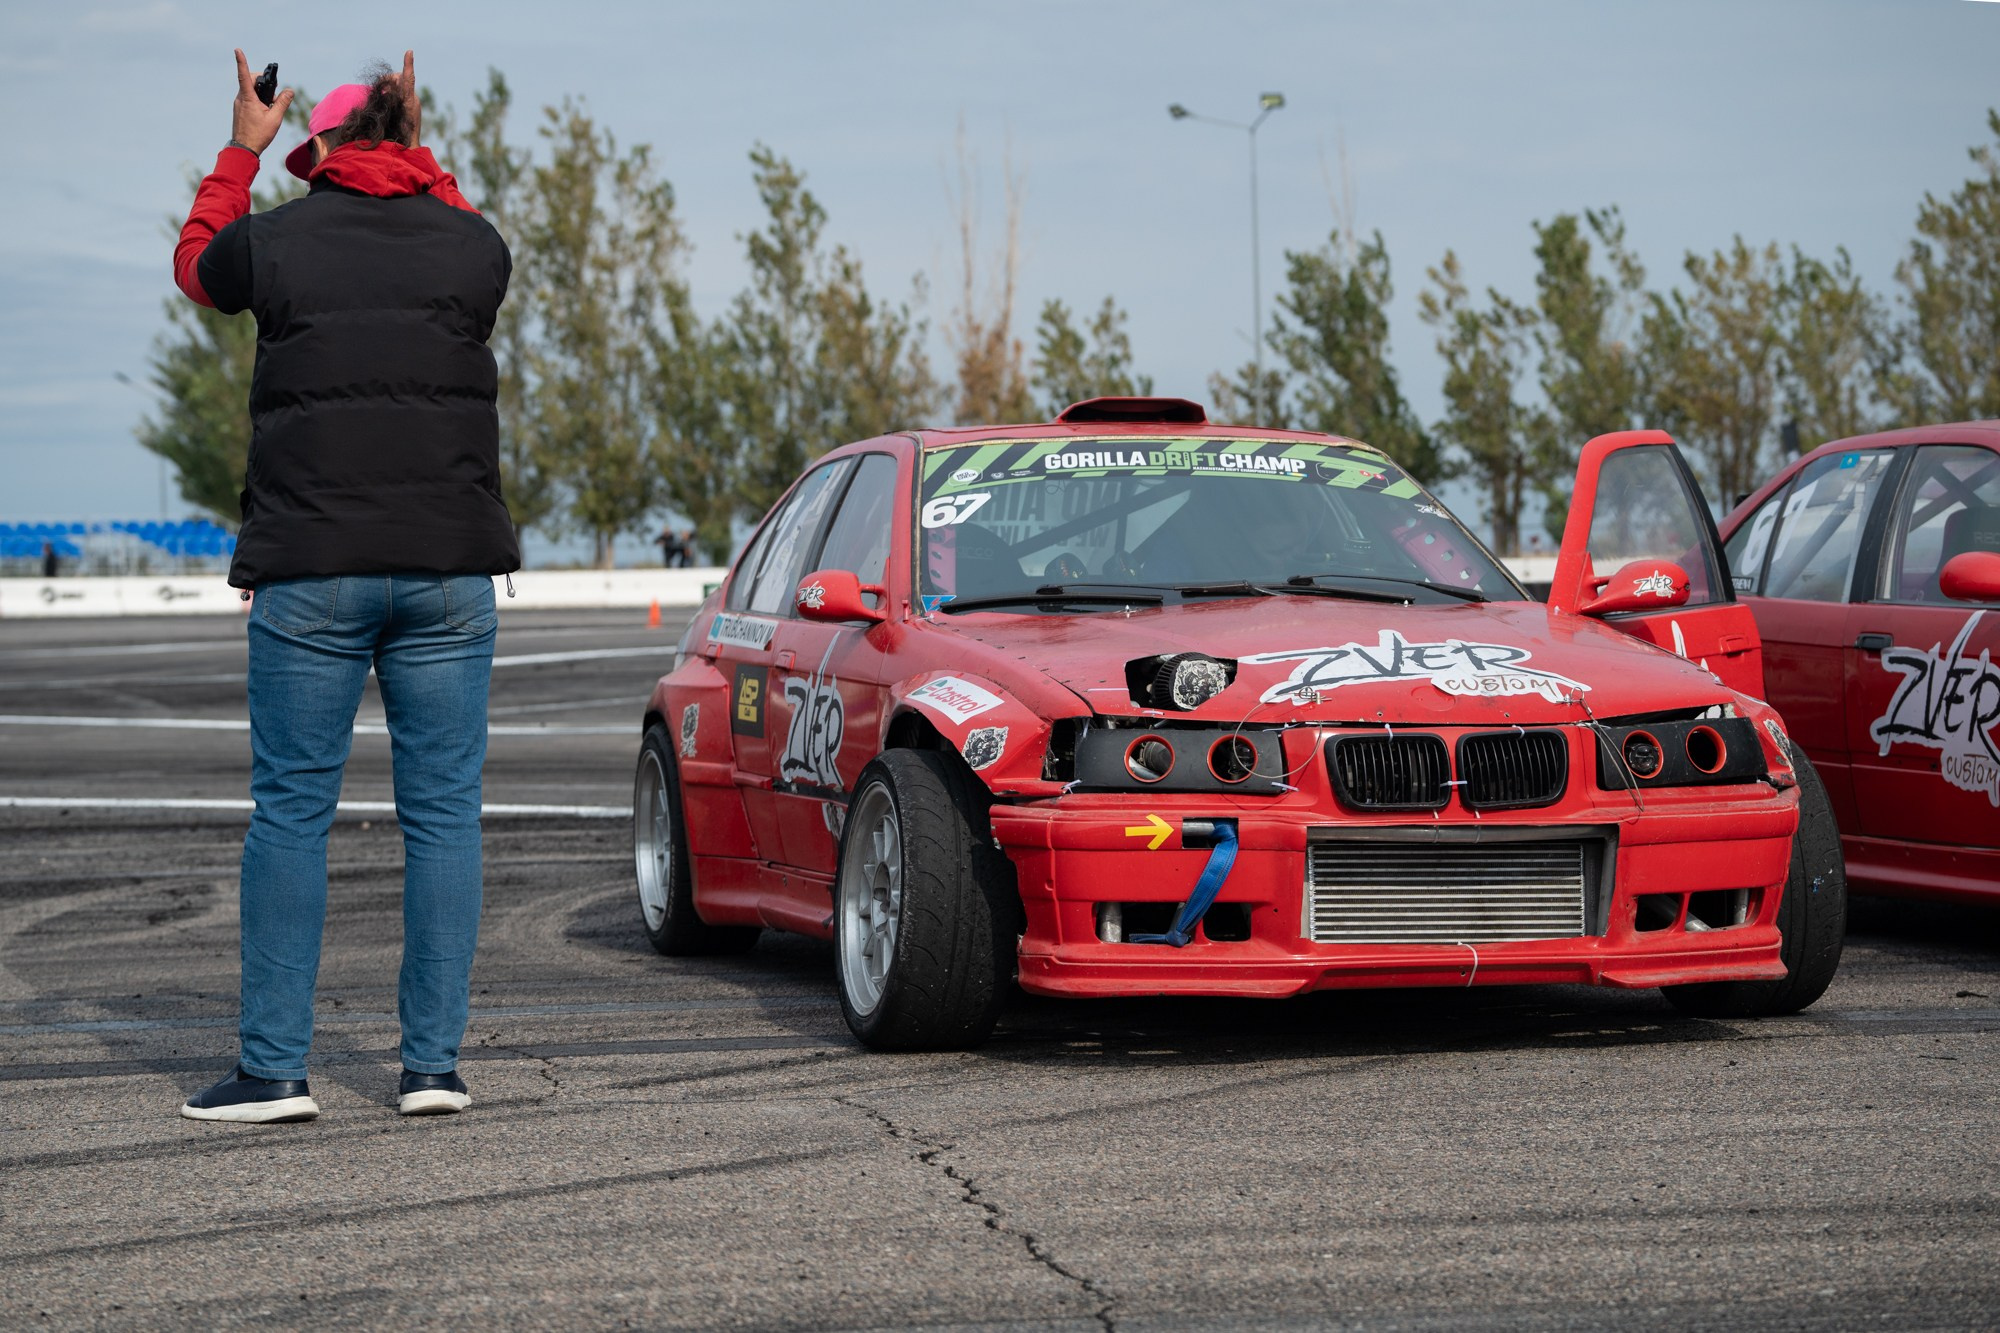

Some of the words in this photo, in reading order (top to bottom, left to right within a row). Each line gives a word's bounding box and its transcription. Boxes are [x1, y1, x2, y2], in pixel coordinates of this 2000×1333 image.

[1044, 450, 1147, 469] GORILLA
[1219, 453, 1306, 473] CHAMP
[922, 490, 992, 529] 67
[1250, 631, 1582, 699] ZVER
[927, 686, 988, 714] Castrol
[1445, 673, 1559, 697] CUSTOM
[1874, 616, 2000, 764] ZVER
[781, 640, 845, 788] ZVER
[1946, 753, 1999, 793] CUSTOM
